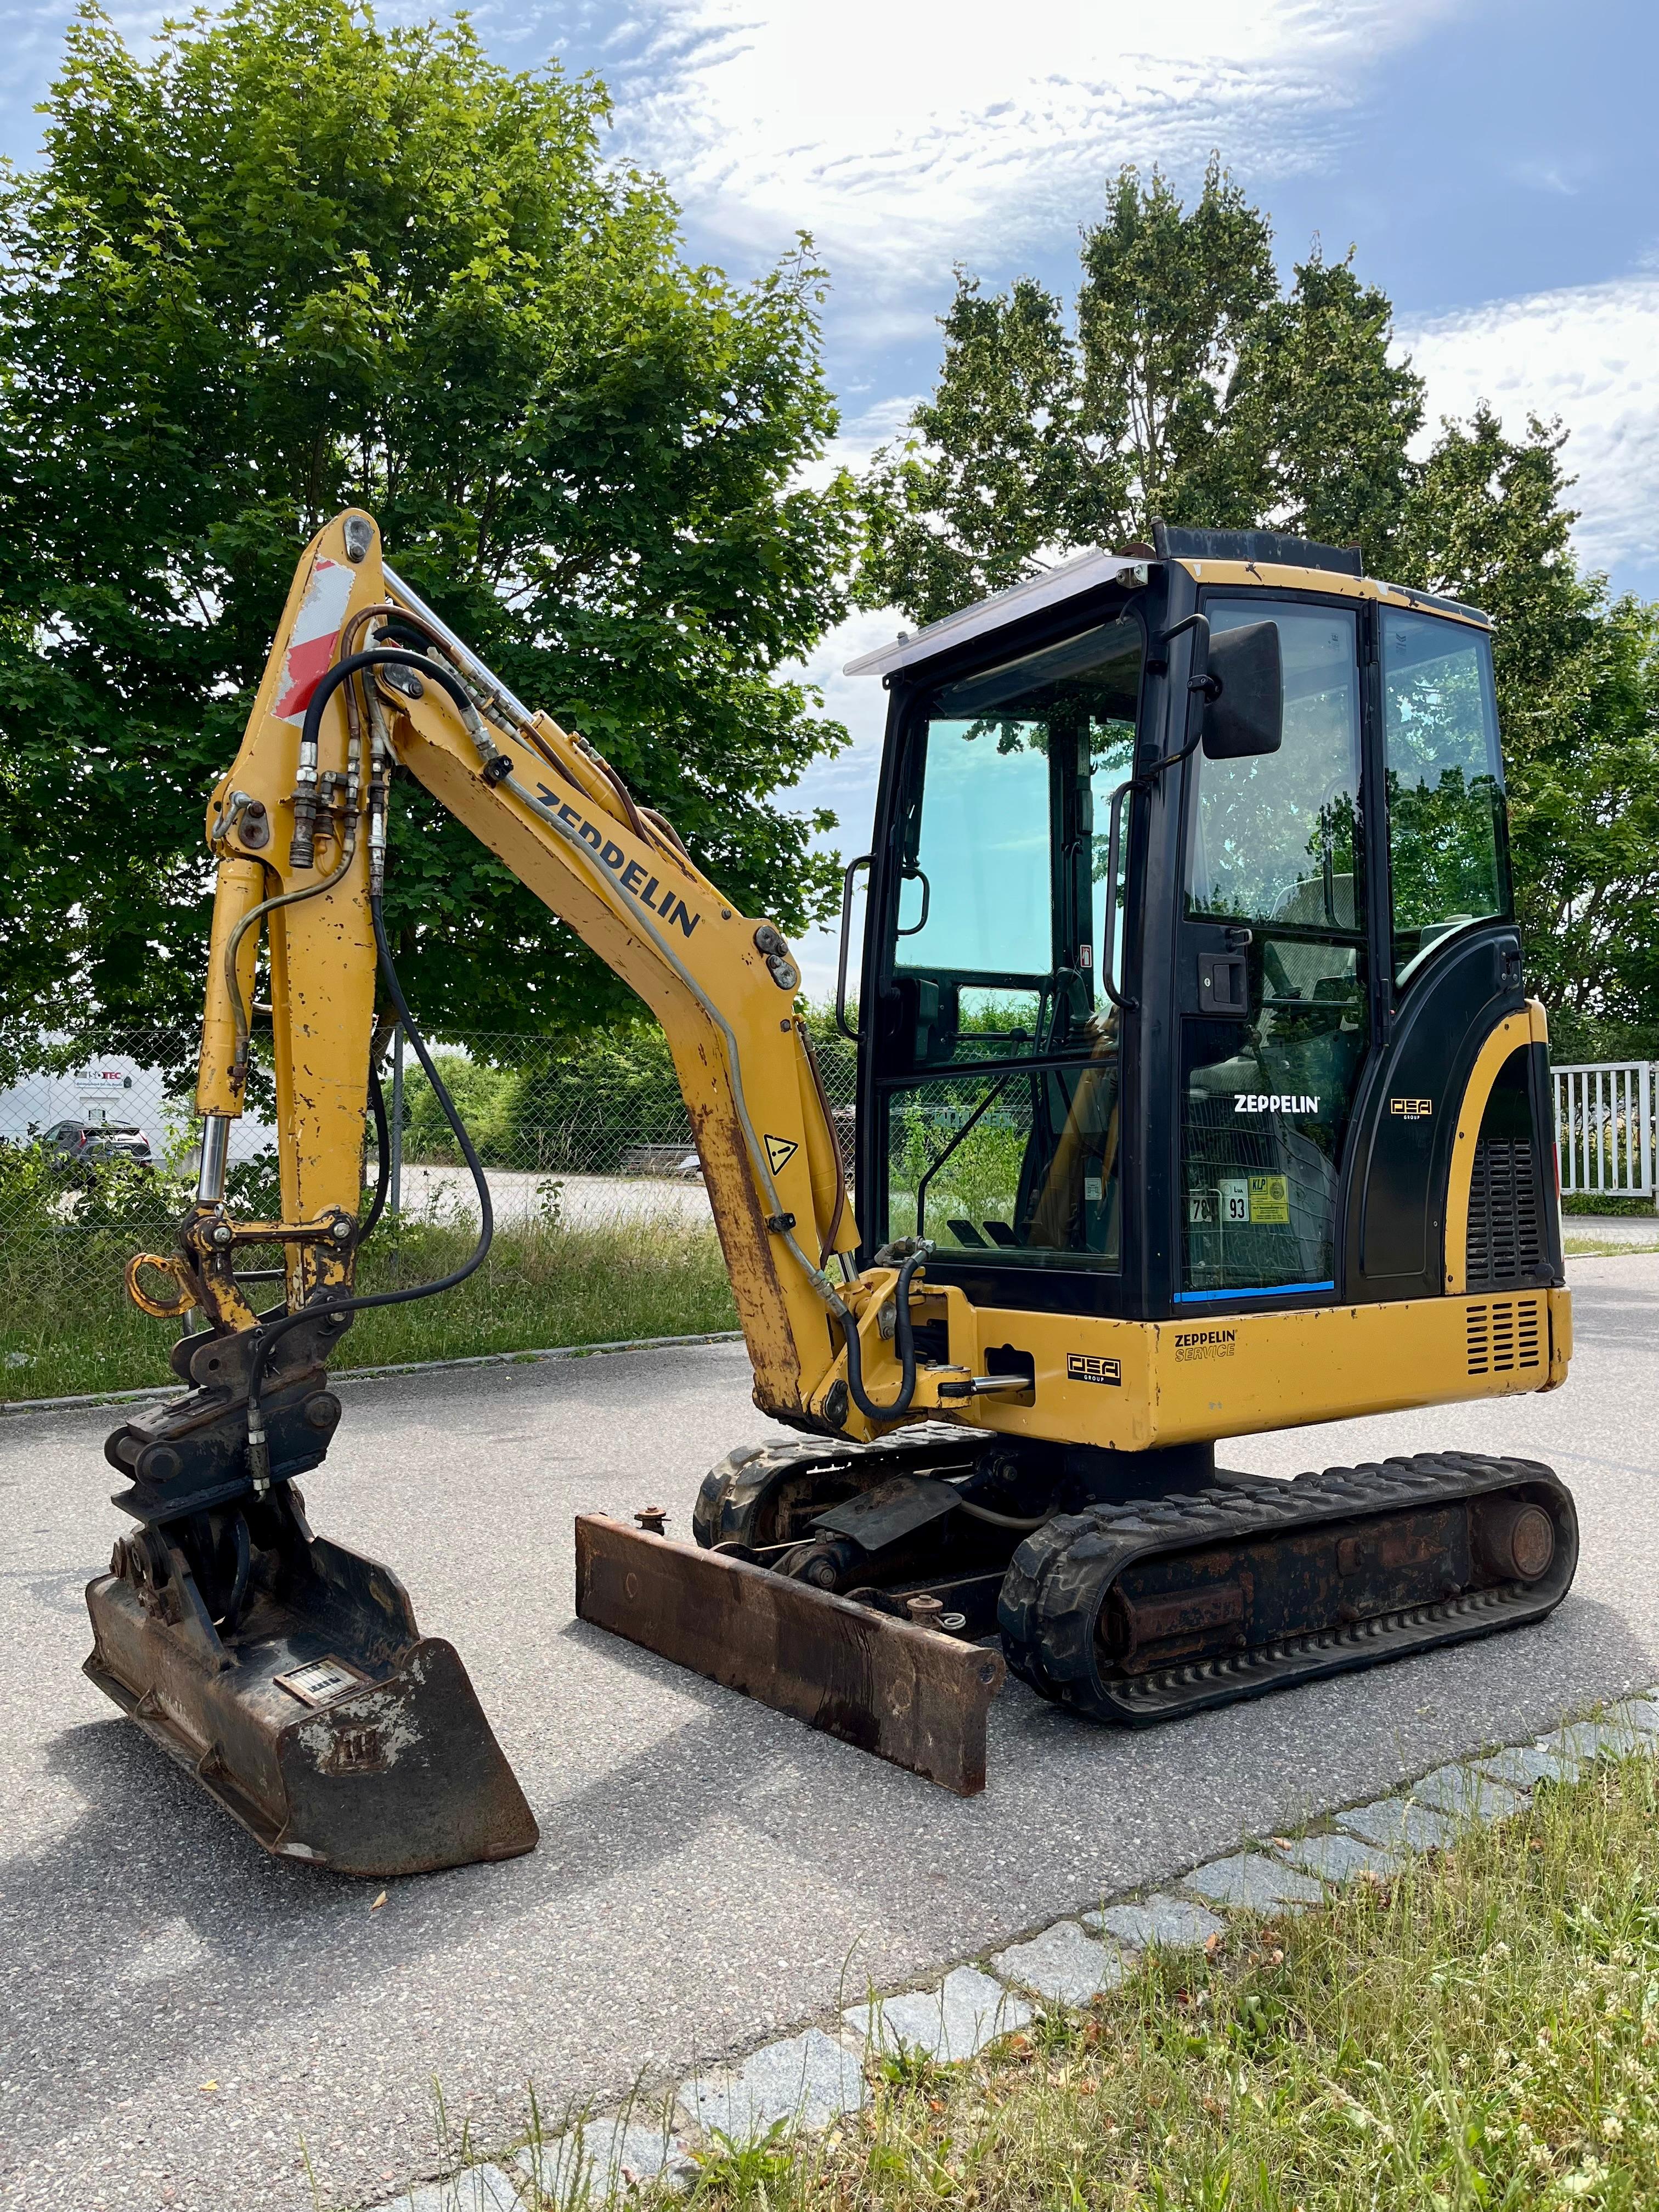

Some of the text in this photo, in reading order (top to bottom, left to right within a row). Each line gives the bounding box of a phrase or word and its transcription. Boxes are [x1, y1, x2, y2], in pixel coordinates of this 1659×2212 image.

[536, 782, 701, 938] ZEPPELIN
[1234, 1094, 1318, 1113] ZEPPELIN
[1252, 1179, 1266, 1190] KLP
[1230, 1199, 1245, 1218] 93
[1175, 1330, 1235, 1347] ZEPPELIN
[1175, 1344, 1235, 1362] SERVICE
